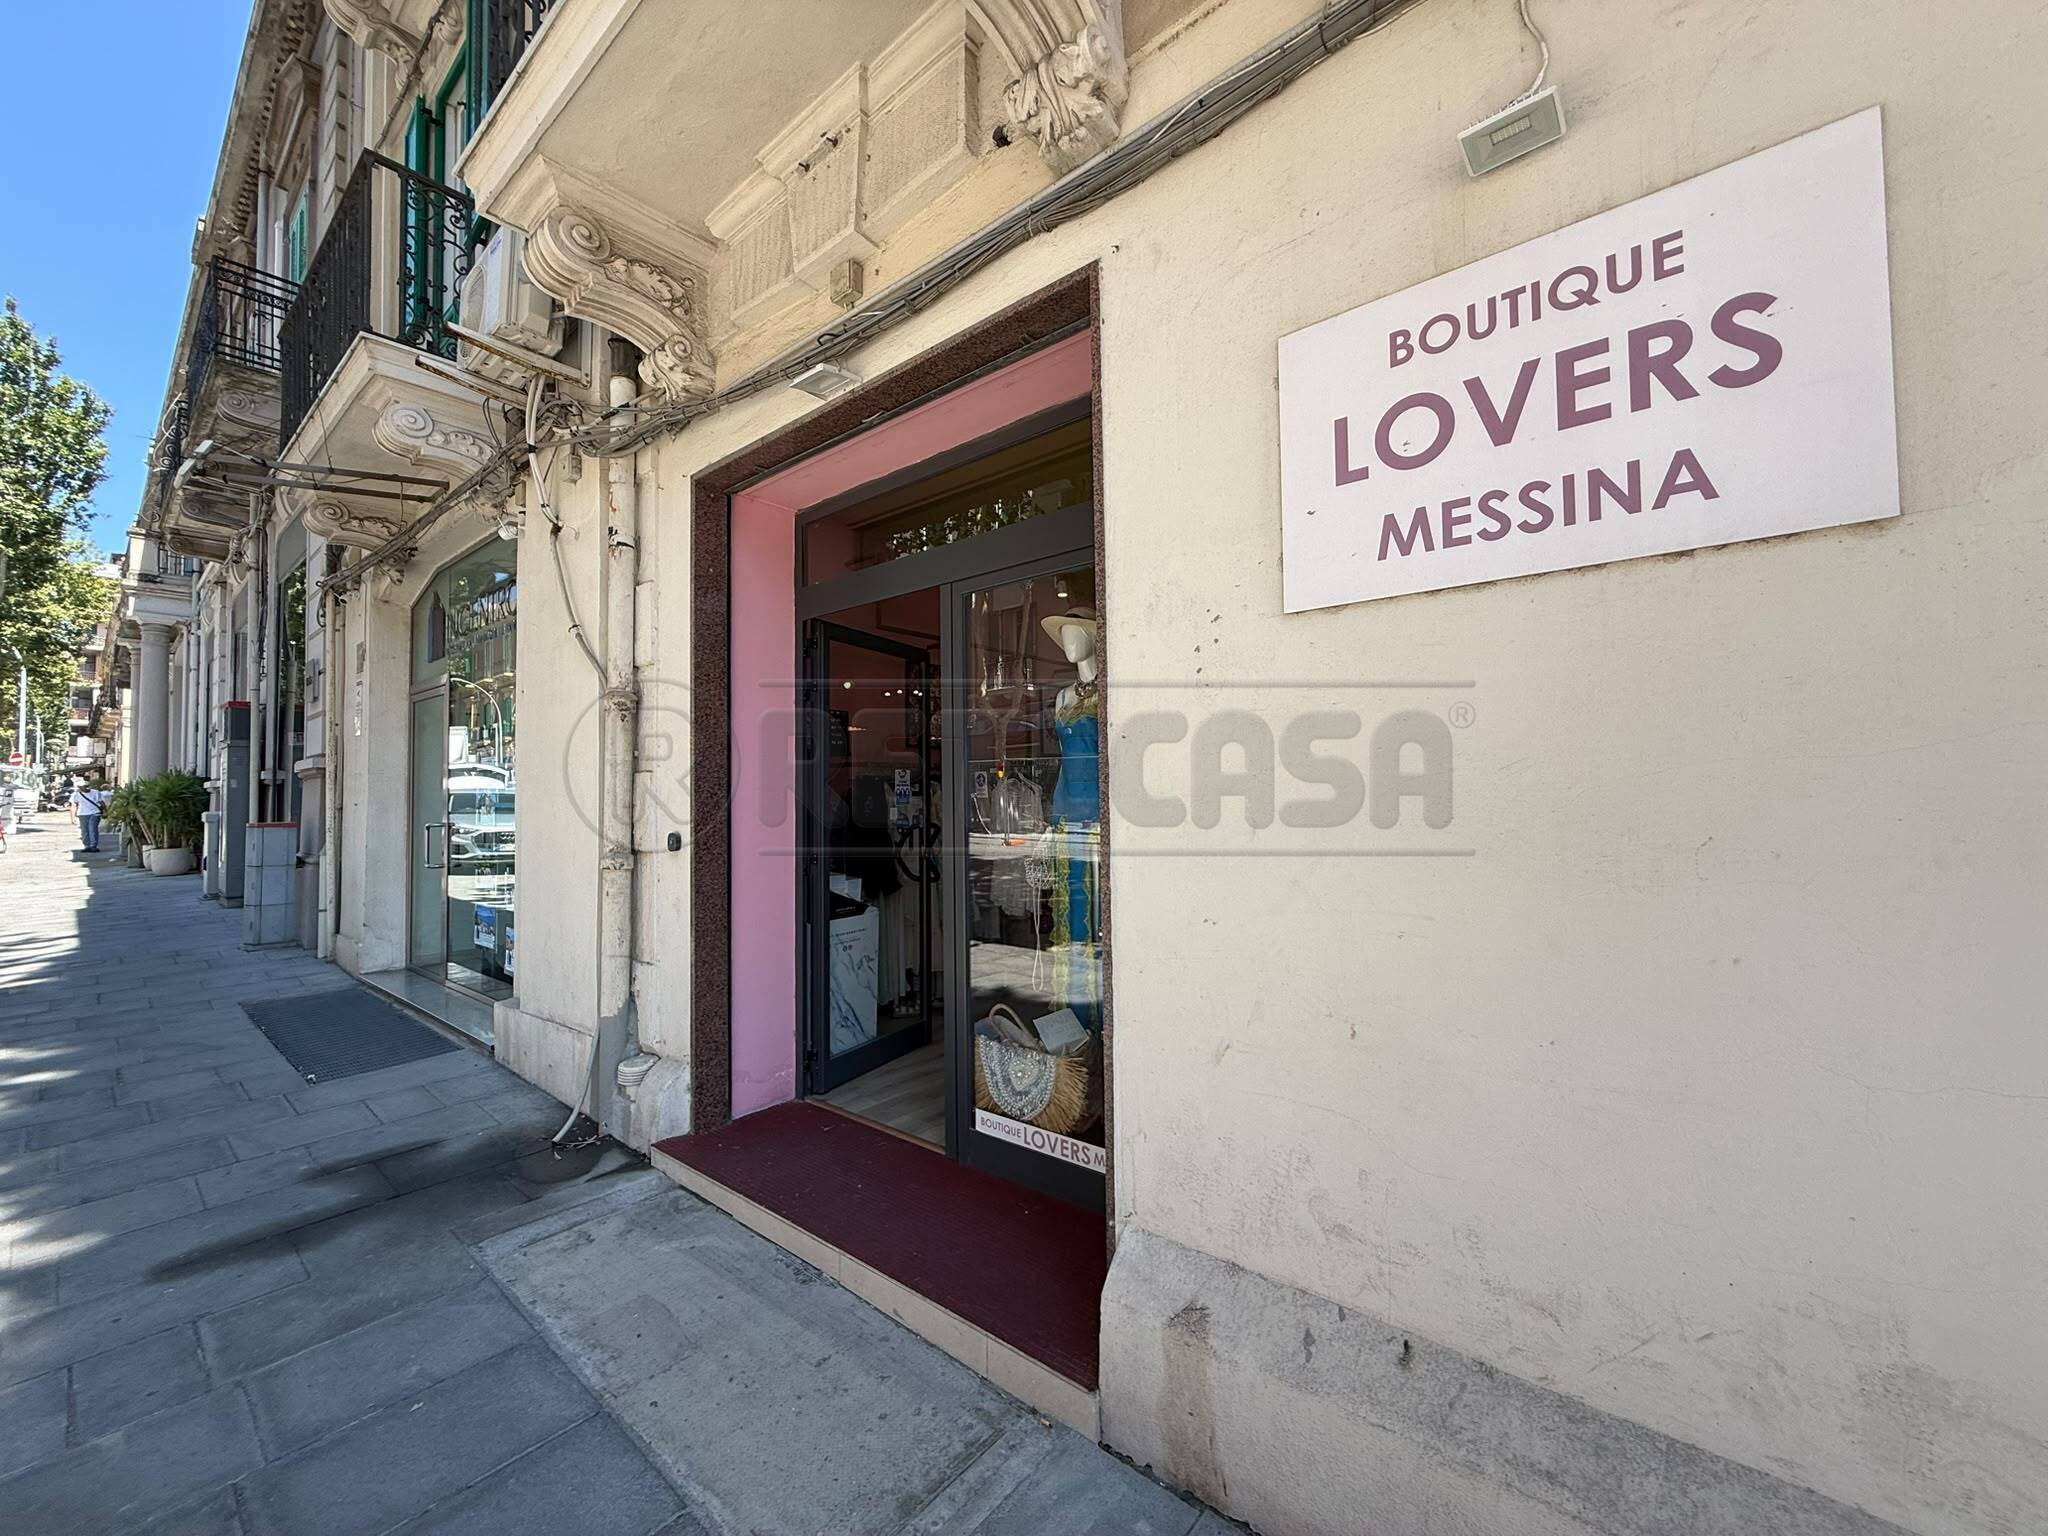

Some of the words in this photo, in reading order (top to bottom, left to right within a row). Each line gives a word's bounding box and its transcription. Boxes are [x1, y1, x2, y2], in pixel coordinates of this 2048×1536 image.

[1388, 230, 1685, 368] BOUTIQUE
[1334, 292, 1782, 486] LOVERS
[1377, 447, 1720, 561] MESSINA
[981, 1117, 1022, 1138] BOUTIQUE
[1024, 1127, 1091, 1165] LOVERS
